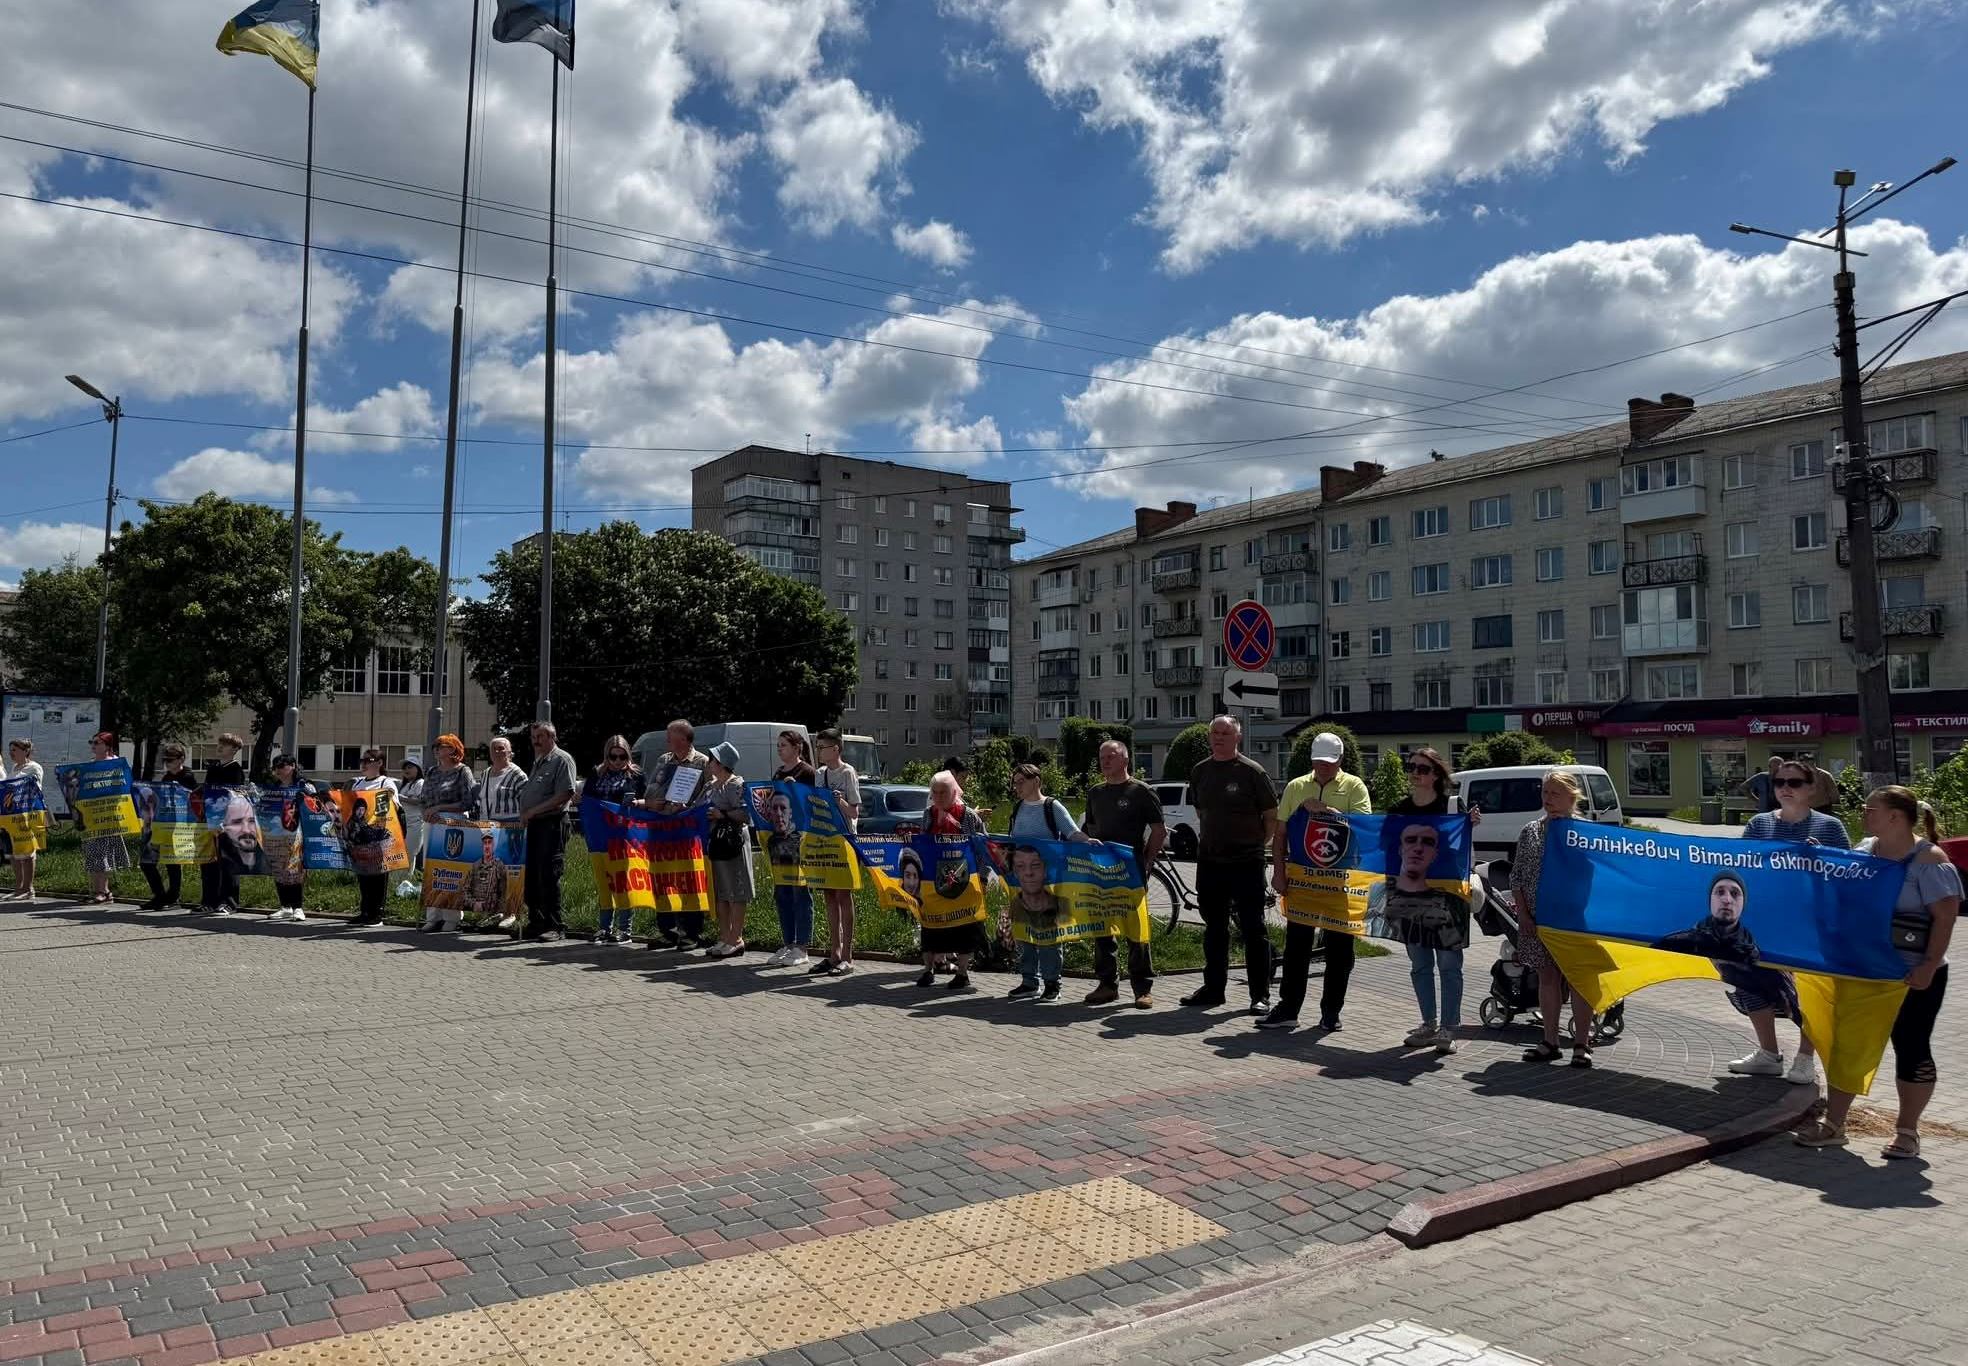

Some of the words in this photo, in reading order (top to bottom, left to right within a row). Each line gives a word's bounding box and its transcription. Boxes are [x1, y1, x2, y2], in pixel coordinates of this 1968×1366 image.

[1544, 712, 1573, 721] ПЕРША
[1664, 723, 1695, 732] ПОСУД
[1761, 721, 1811, 735] Family
[1566, 829, 1680, 862] Валінкевич
[1688, 844, 1763, 870] Віталій
